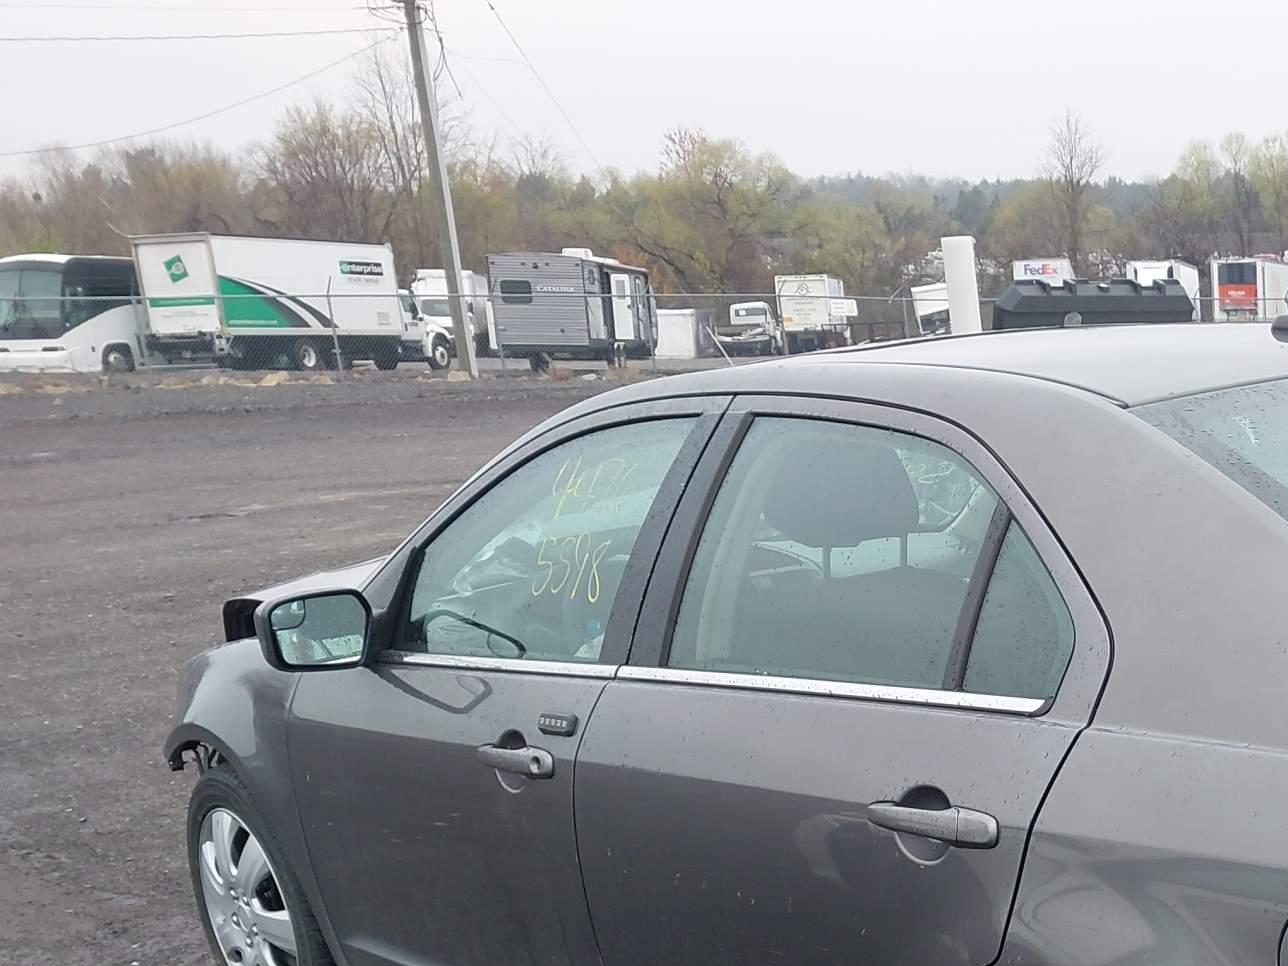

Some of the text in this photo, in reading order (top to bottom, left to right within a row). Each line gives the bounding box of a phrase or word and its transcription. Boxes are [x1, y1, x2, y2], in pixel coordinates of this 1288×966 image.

[341, 263, 384, 274] enterprise
[1023, 263, 1058, 276] FedEx
[531, 532, 613, 604] 5598
